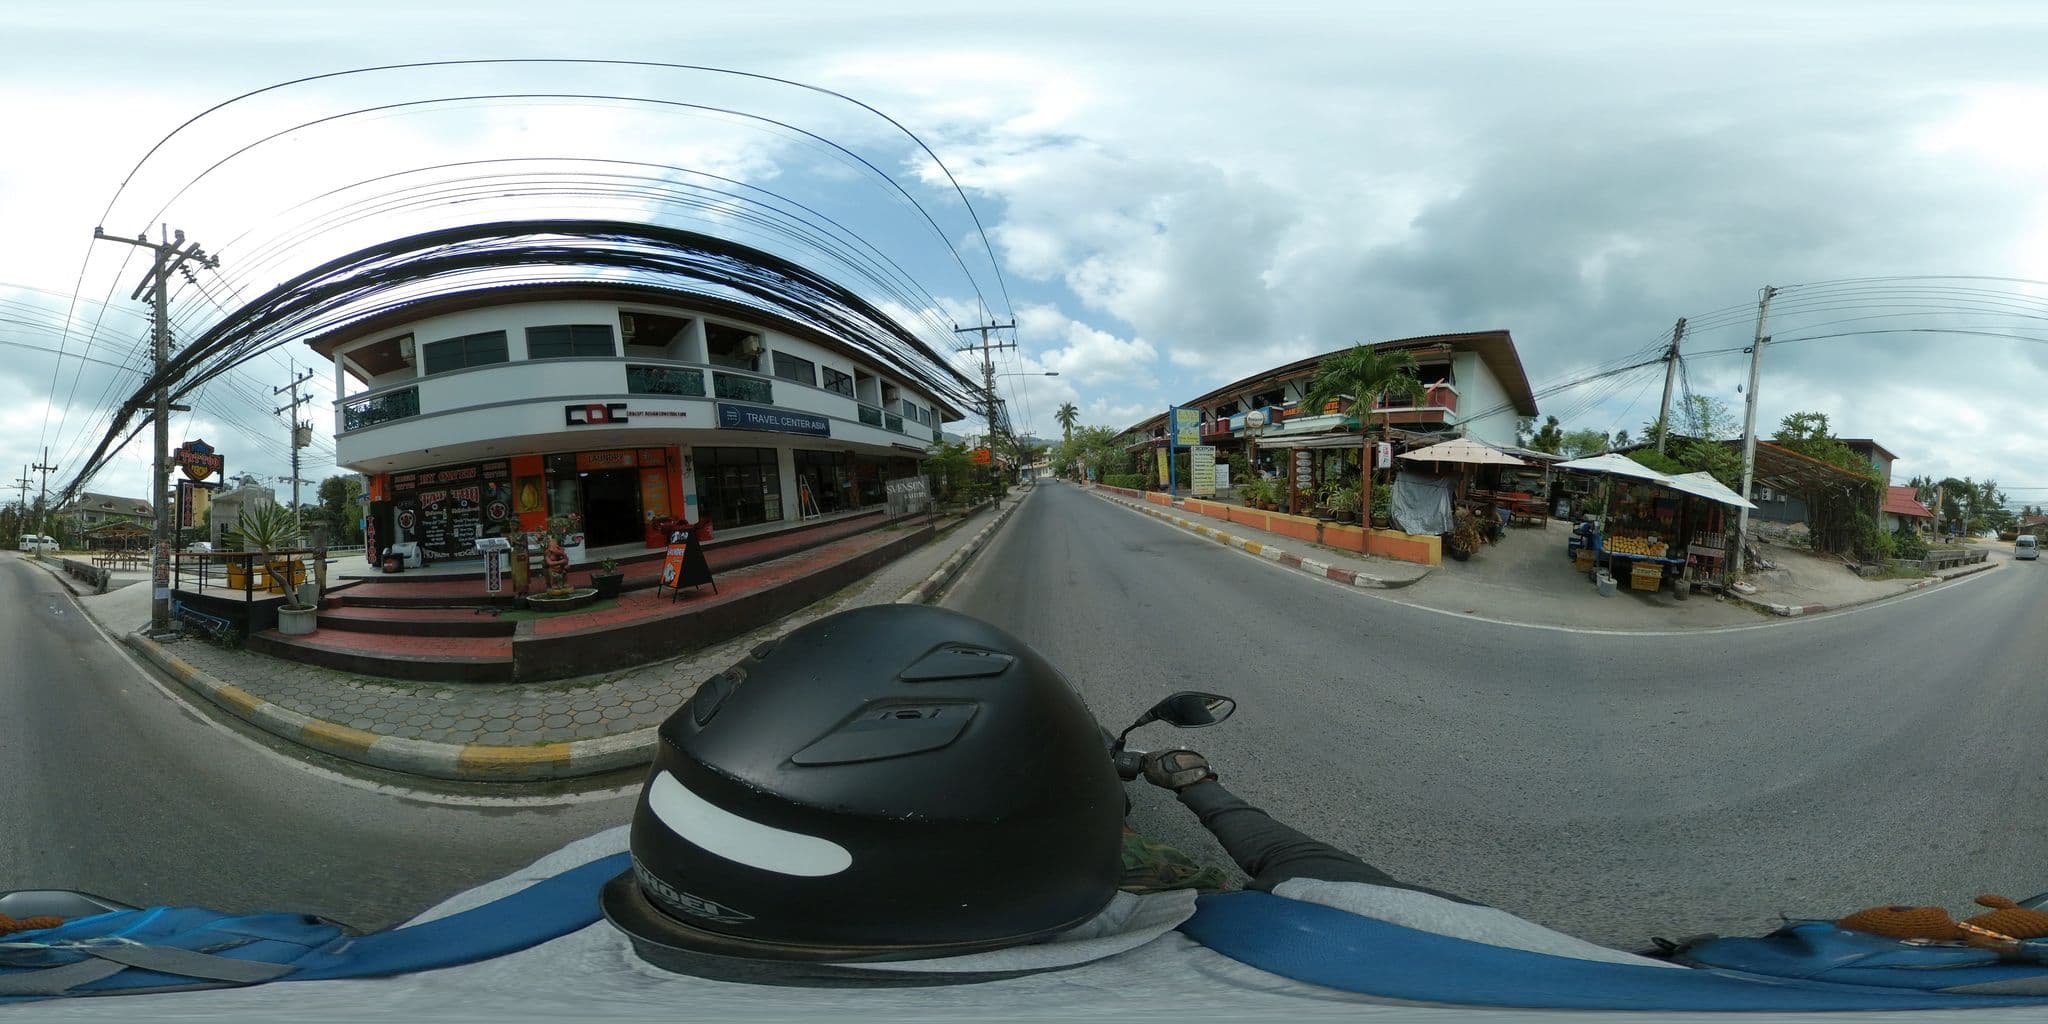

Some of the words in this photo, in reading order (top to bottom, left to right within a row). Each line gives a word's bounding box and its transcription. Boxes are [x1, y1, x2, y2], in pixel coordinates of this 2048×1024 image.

[746, 412, 780, 425] TRAVEL
[780, 416, 810, 429] CENTER
[811, 421, 826, 431] ASIA
